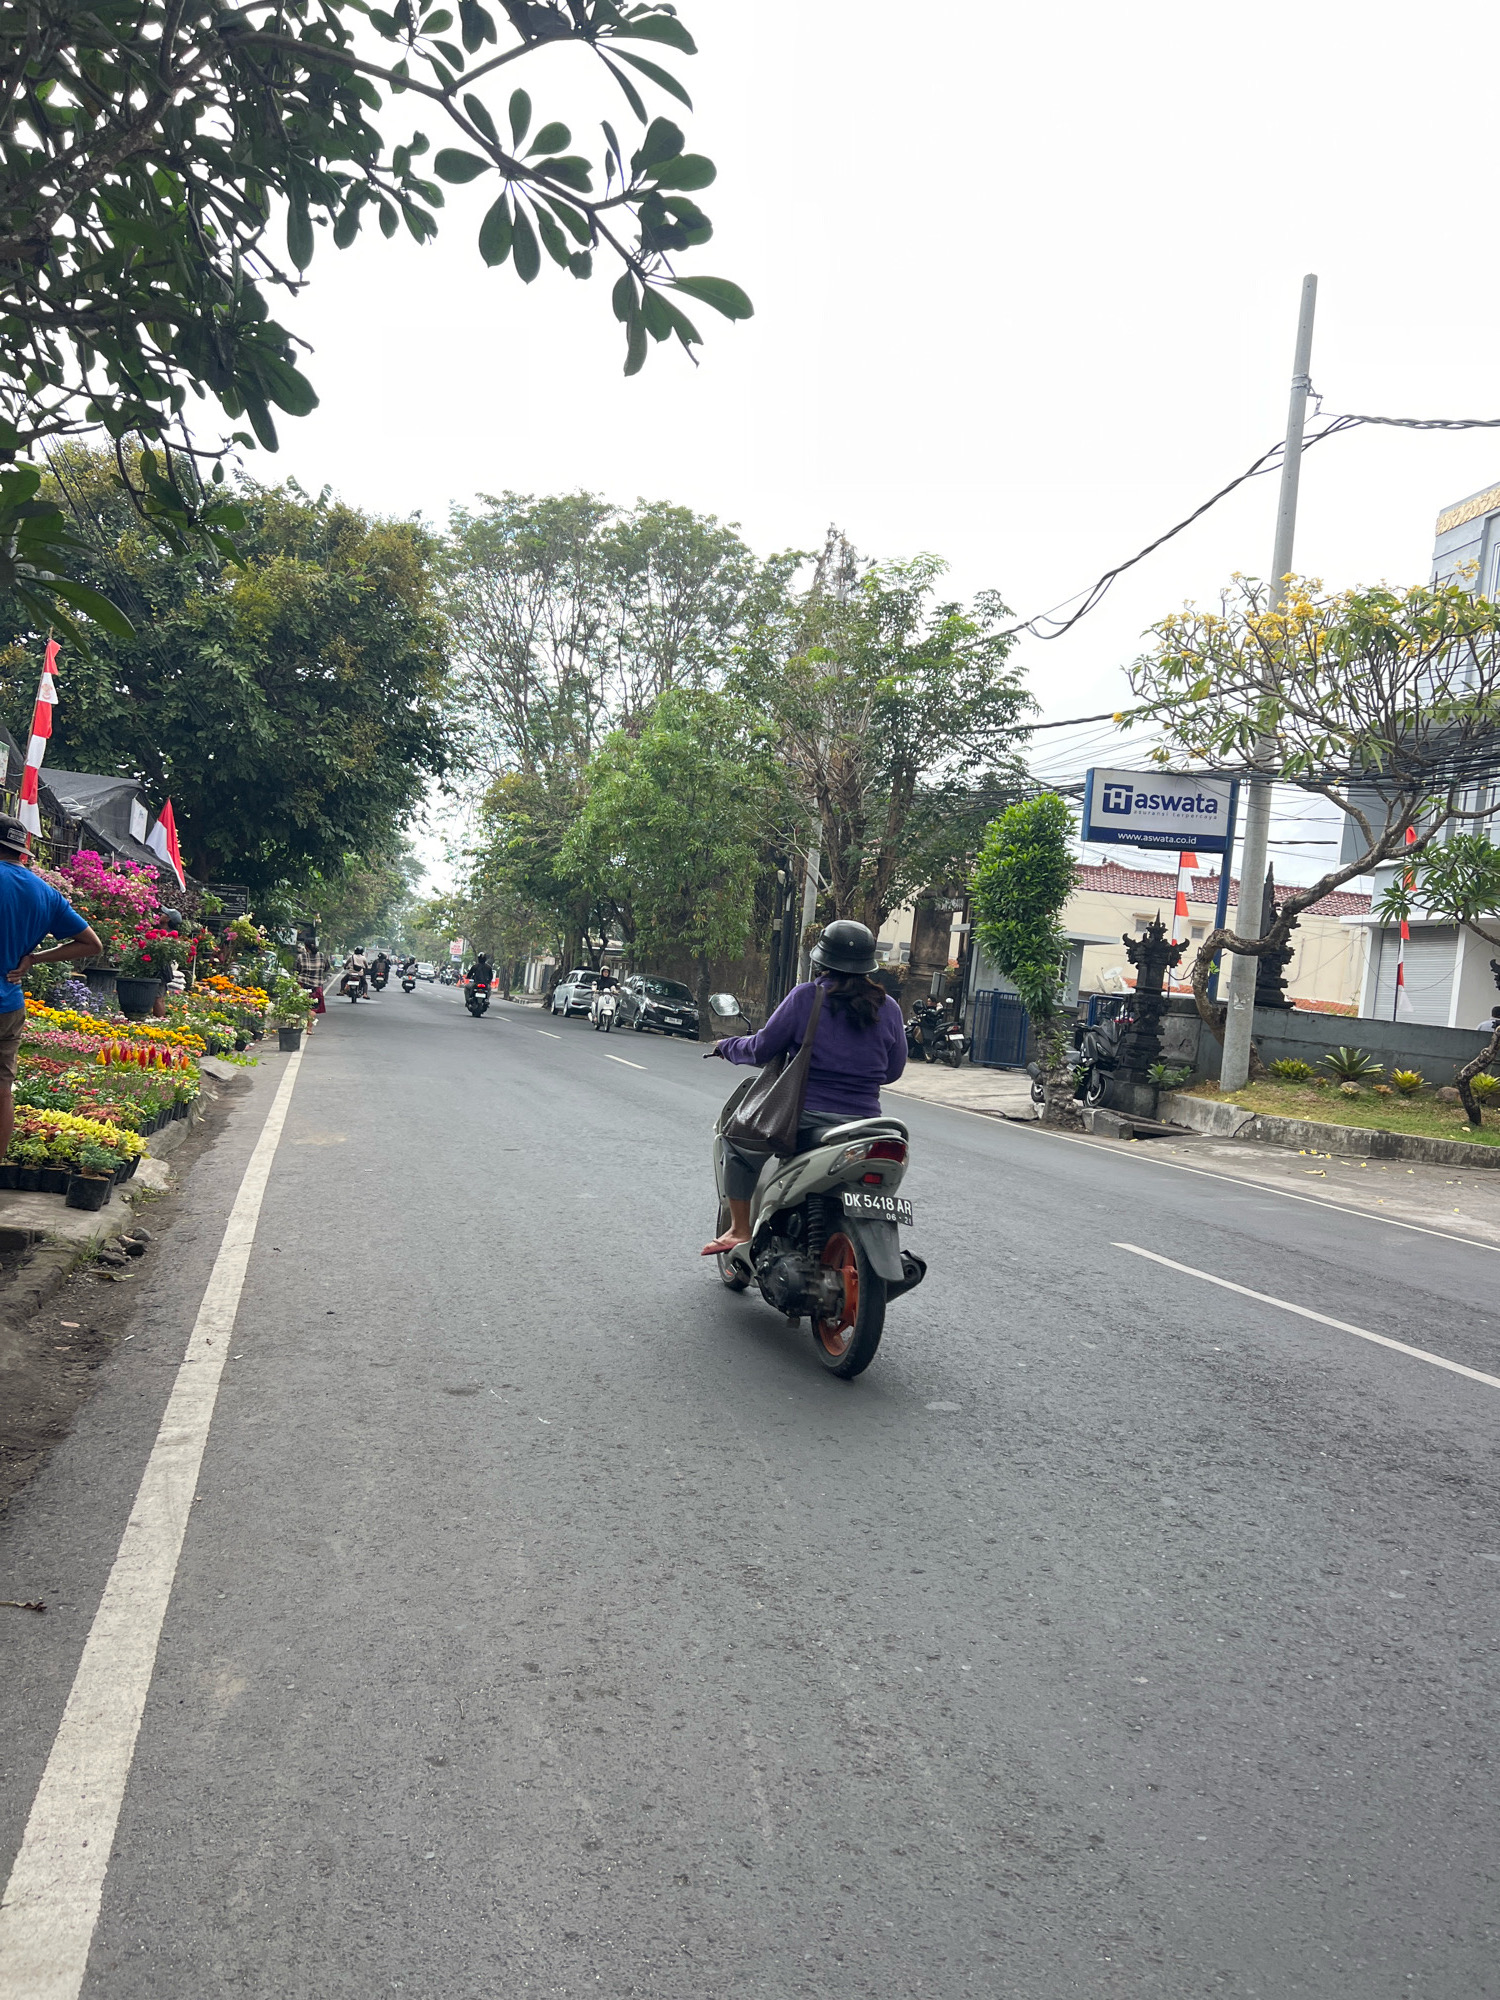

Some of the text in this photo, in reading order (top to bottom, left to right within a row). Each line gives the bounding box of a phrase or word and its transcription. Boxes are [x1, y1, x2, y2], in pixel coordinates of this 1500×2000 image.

[1134, 793, 1218, 814] aswata
[1172, 812, 1217, 820] terpercaya
[1117, 832, 1197, 845] www.aswata.co.id
[844, 1193, 912, 1215] DK 5418 AR
